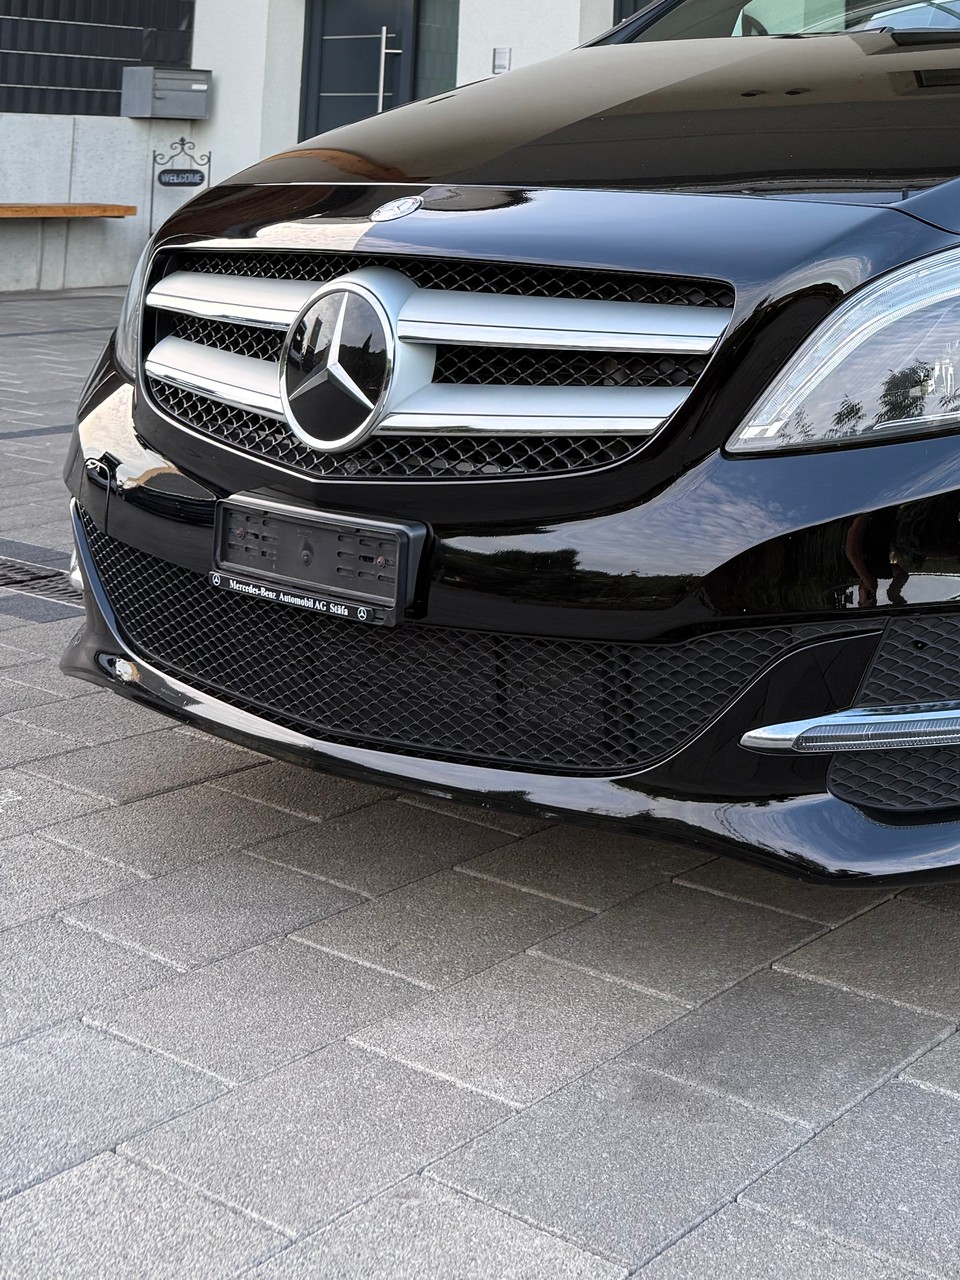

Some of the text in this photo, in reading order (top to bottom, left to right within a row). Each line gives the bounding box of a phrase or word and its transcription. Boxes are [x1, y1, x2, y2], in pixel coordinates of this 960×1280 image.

[160, 173, 202, 183] WELCOME
[229, 579, 349, 616] Mercedes-Benz Automobil AG Stäfa
